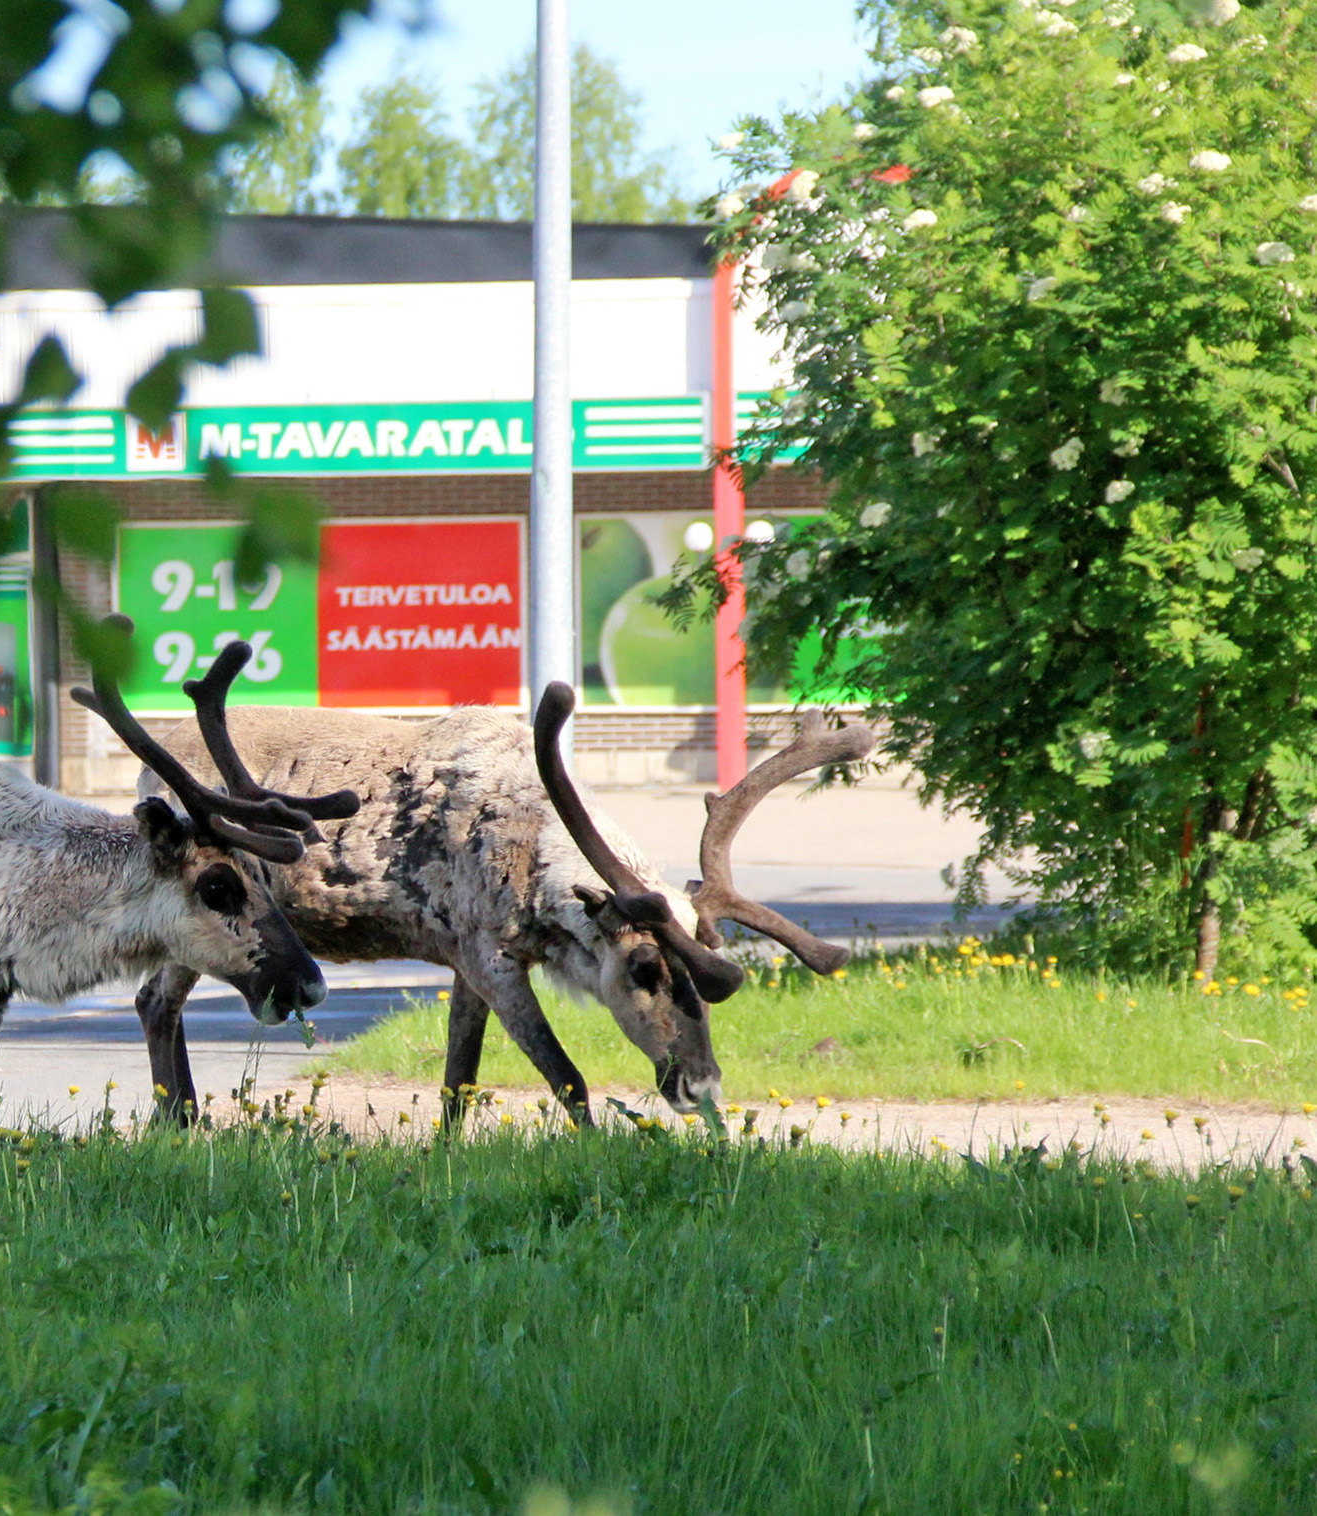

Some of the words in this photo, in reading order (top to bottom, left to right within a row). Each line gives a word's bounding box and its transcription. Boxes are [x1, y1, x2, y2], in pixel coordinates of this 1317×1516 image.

[136, 418, 176, 459] M
[199, 418, 575, 460] M-TAVARATAL
[335, 583, 513, 607] TERVETULOA
[326, 623, 521, 651] SÄÄSTÄMÄÄN
